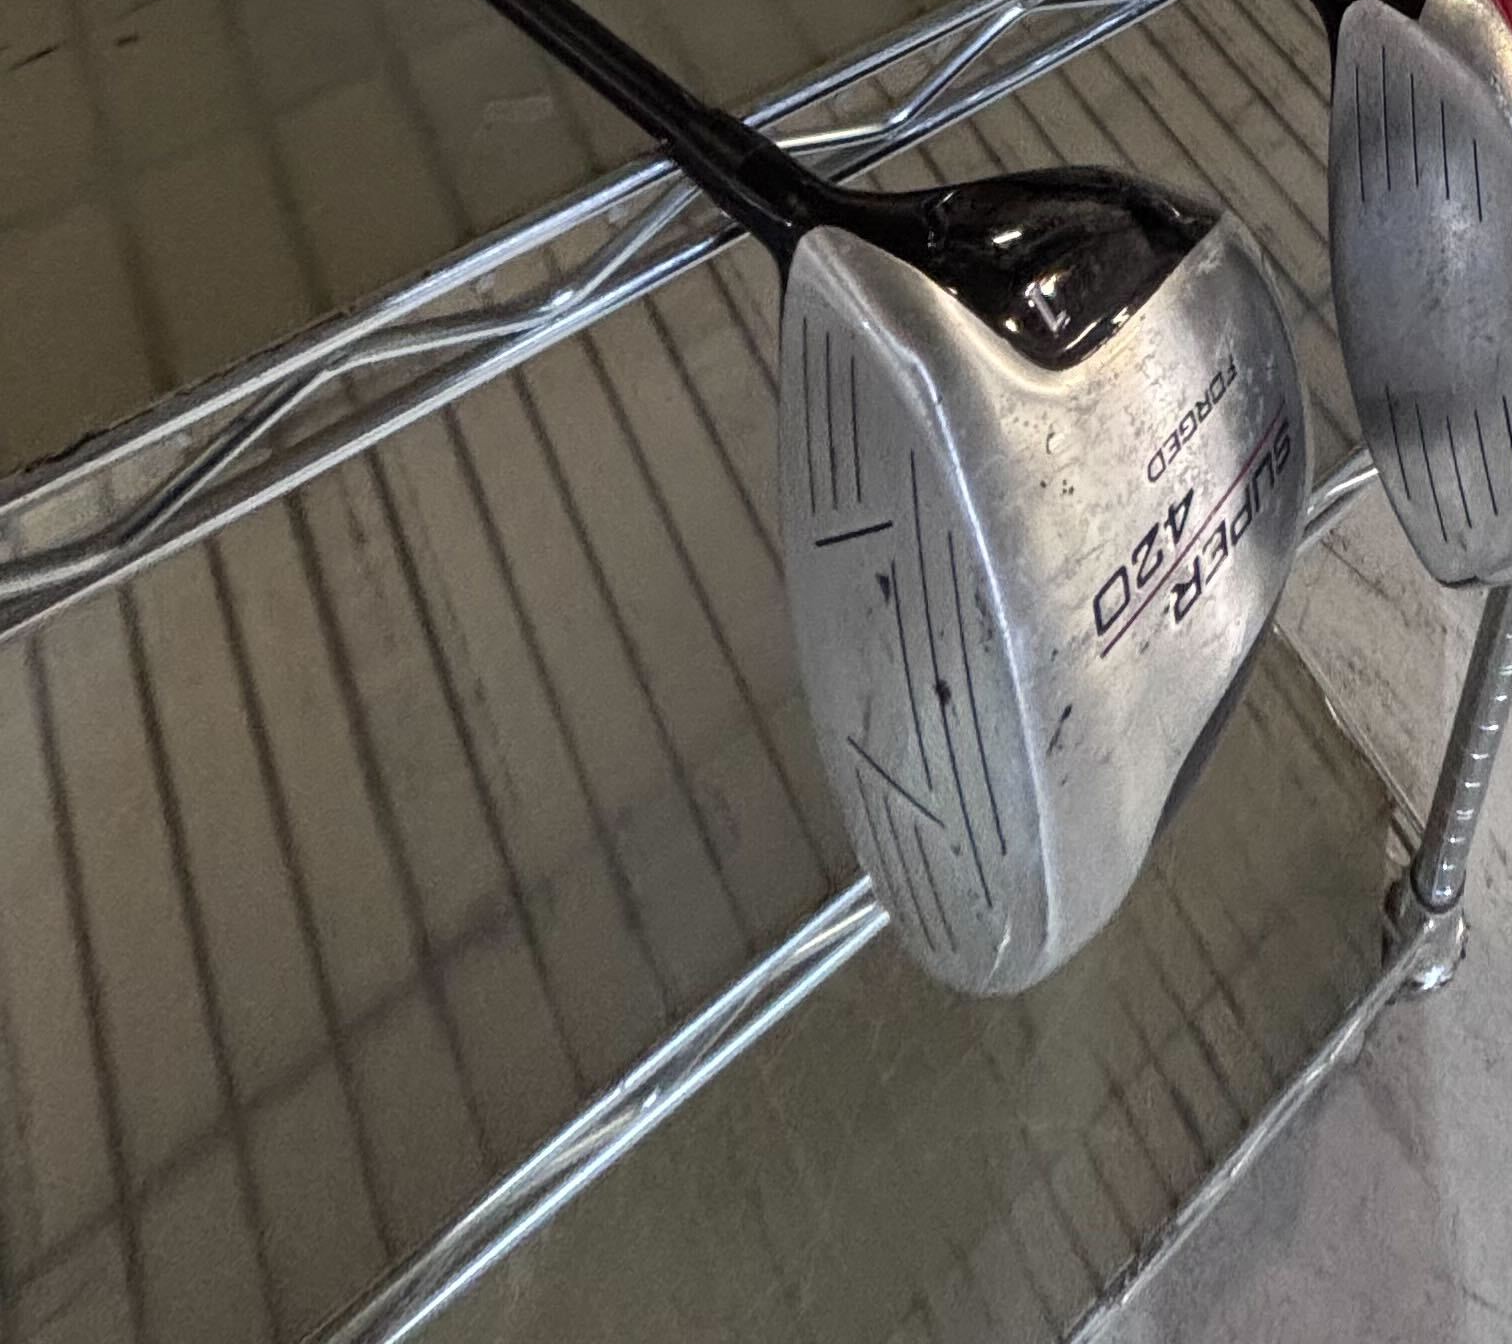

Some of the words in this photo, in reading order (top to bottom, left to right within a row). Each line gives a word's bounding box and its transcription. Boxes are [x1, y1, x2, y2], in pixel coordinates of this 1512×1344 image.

[1144, 354, 1242, 484] FORGED
[1093, 488, 1193, 637] 420
[1172, 422, 1292, 625] SUPER
